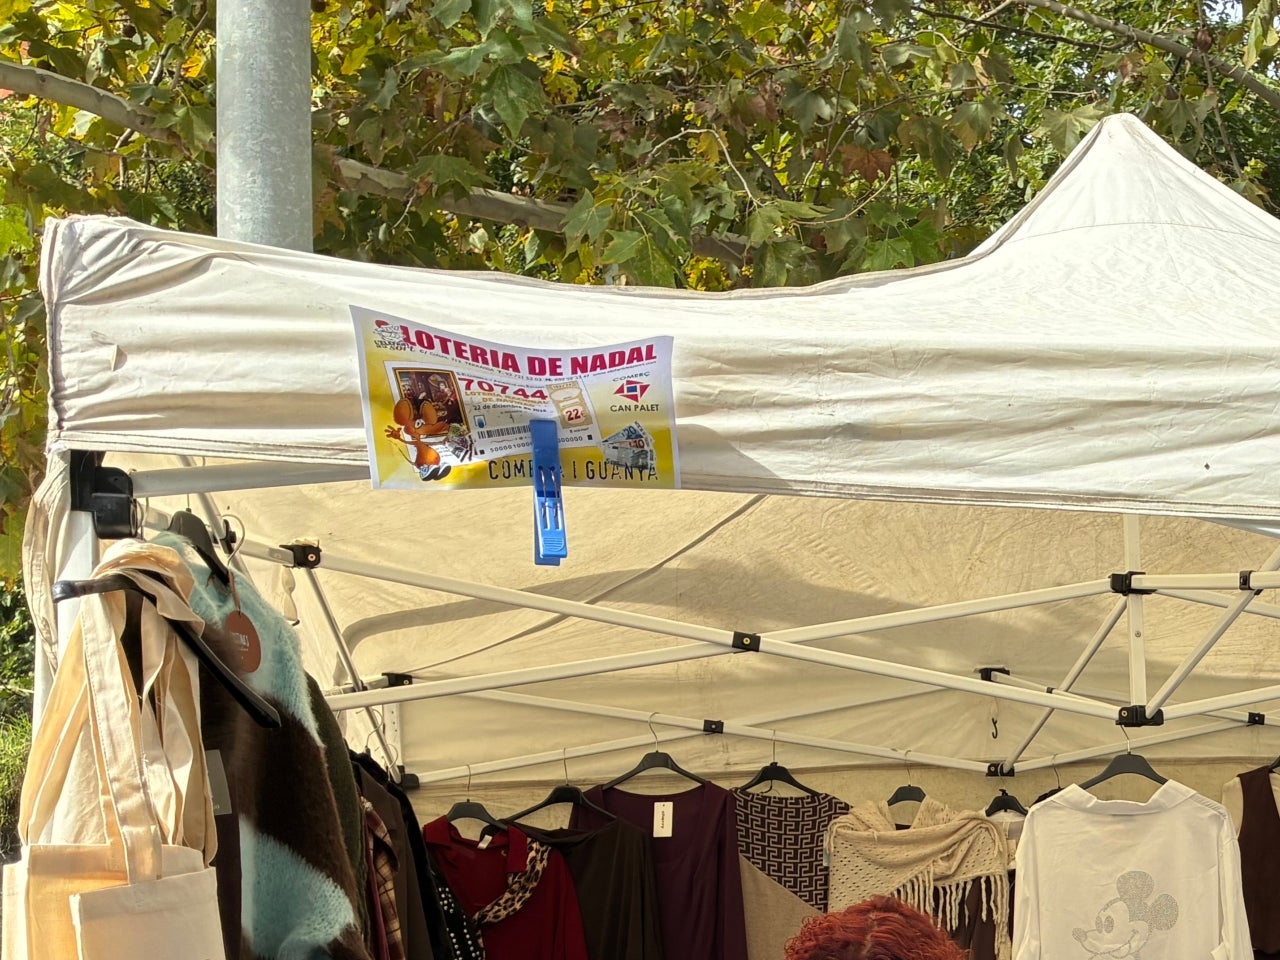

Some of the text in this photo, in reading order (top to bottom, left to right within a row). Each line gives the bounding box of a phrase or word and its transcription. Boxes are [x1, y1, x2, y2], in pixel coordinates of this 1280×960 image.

[400, 325, 521, 372] LOTERIA
[527, 356, 563, 376] DE
[570, 344, 657, 375] NADAL
[458, 377, 548, 400] 70744
[610, 404, 659, 412] CAN PALET
[586, 460, 659, 480] GUANYA
